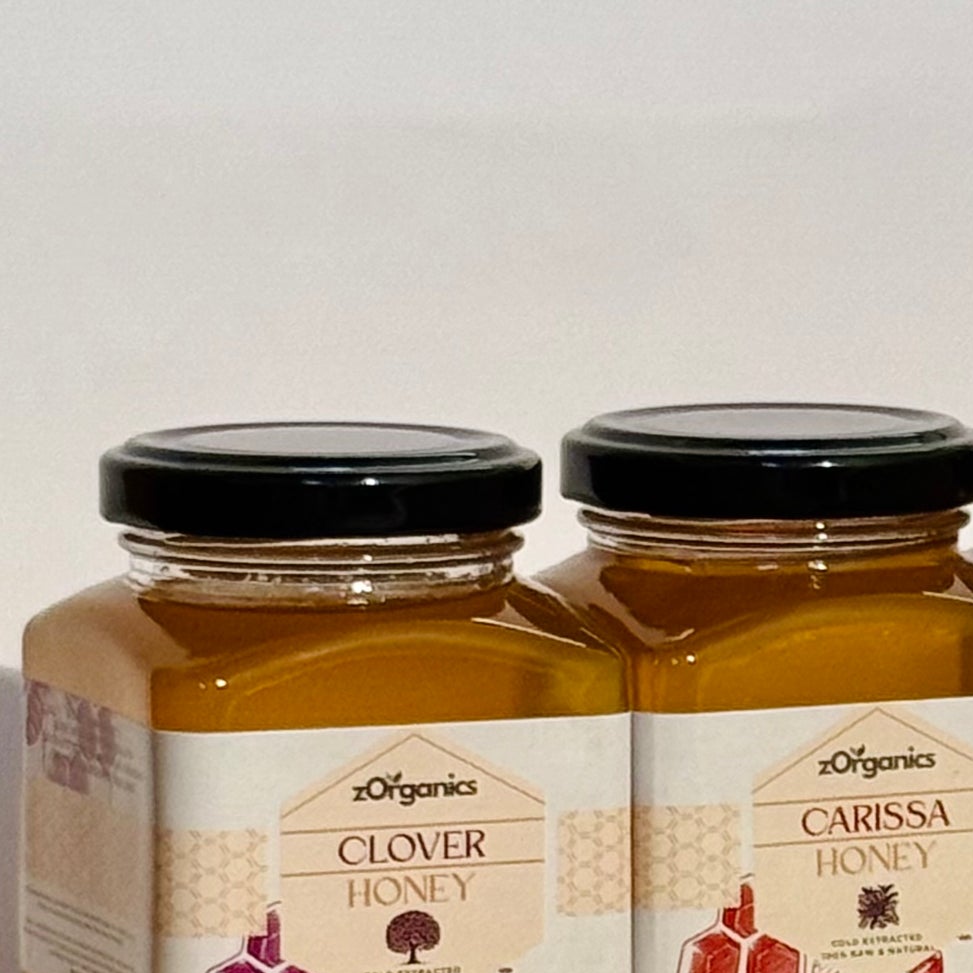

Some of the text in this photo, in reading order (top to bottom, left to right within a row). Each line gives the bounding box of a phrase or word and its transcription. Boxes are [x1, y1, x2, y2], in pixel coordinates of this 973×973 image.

[818, 744, 936, 779] zOrganics
[352, 771, 478, 807] zOrganics
[802, 799, 950, 837] CARISSA
[338, 830, 486, 866] CLOVER
[816, 840, 936, 877] HONEY
[348, 873, 475, 909] HONEY
